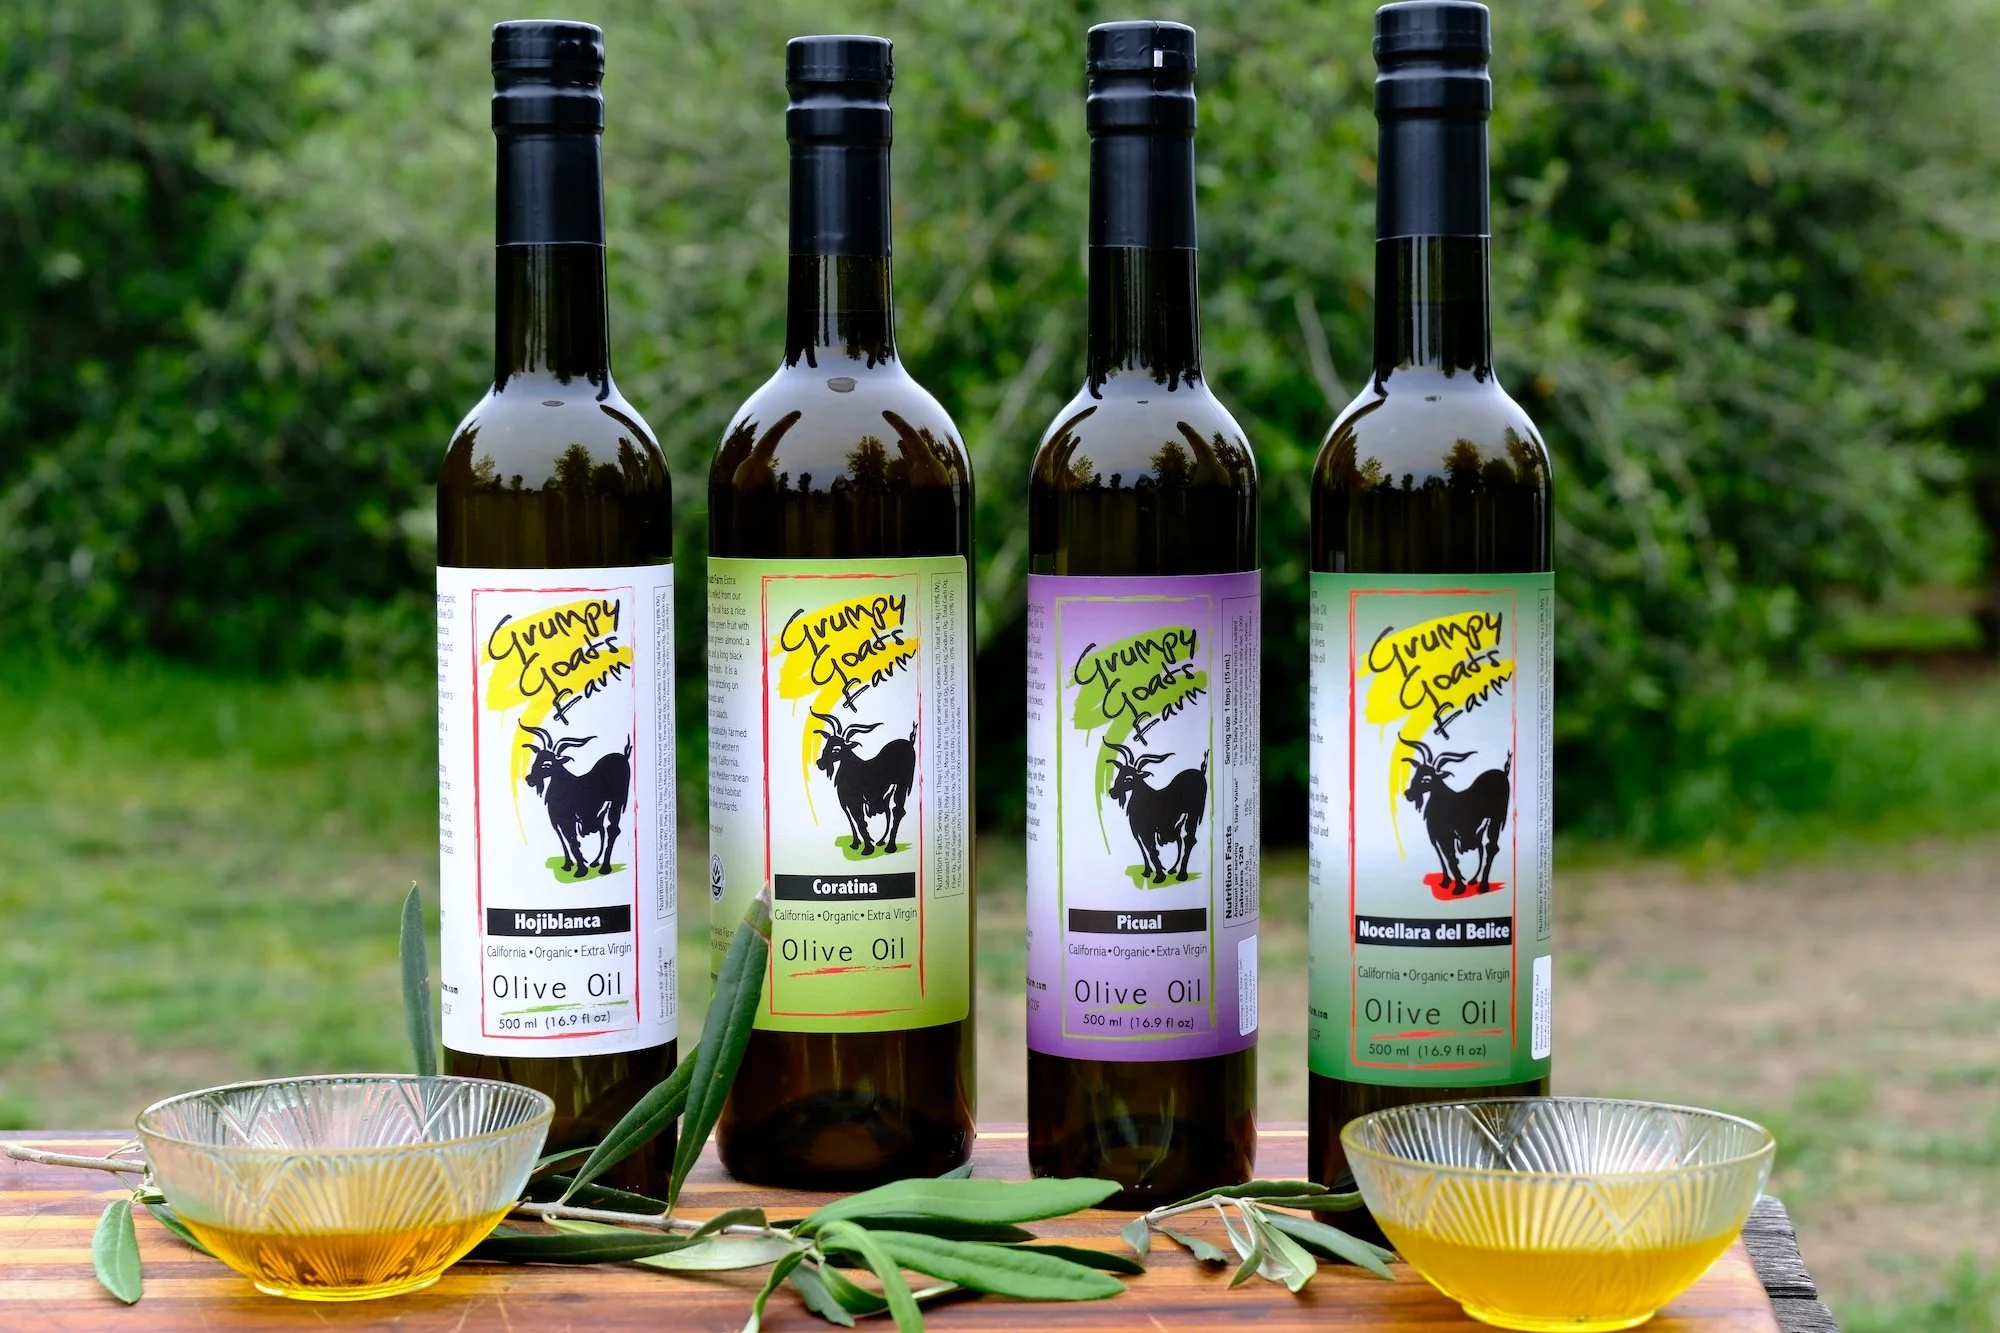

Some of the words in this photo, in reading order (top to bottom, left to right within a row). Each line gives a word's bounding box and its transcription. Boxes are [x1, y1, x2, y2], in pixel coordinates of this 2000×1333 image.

[488, 598, 620, 667] Grumpy
[781, 594, 906, 655] Grumpy
[810, 627, 905, 685] Goats
[1368, 612, 1503, 677] Grumpy
[520, 635, 619, 698] Goats
[1074, 628, 1197, 689] Grumpy
[842, 649, 917, 713] Farm
[1102, 663, 1194, 719] Goats
[1400, 648, 1500, 709] Goats
[553, 661, 630, 725] Farm
[1224, 686, 1232, 706] tbsp.
[1433, 672, 1512, 740] Farm
[1133, 686, 1206, 746] Farm
[1224, 734, 1232, 765] Serving
[813, 879, 877, 895] Coratina
[515, 913, 601, 934] Hojiblanca
[775, 908, 814, 921] California
[822, 909, 859, 924] Organic
[867, 909, 891, 920] Extra
[894, 908, 917, 921] Virgin
[1117, 915, 1162, 930] Picual
[1359, 921, 1430, 940] Nocellara
[1436, 923, 1461, 940] del
[1466, 923, 1510, 939] Belice
[487, 945, 526, 958] California
[535, 945, 573, 960] Organic
[581, 945, 605, 956] Extra
[608, 942, 632, 957] Virgin
[782, 939, 852, 962] Olive
[872, 938, 905, 960] Oil
[1068, 944, 1106, 957] California
[1113, 946, 1150, 959] Organic
[1156, 946, 1180, 956] Extra
[1183, 944, 1207, 957] Virgin
[493, 974, 566, 998] Olive
[588, 972, 621, 997] Oil
[1358, 966, 1400, 980] California
[1408, 968, 1448, 984] Organic
[1457, 969, 1482, 980] Extra
[1485, 968, 1510, 982] Virgin
[1075, 980, 1147, 1005] Olive
[1168, 979, 1201, 1003] Oil
[499, 1018, 520, 1029] 500
[524, 1018, 537, 1028] ml
[546, 1015, 577, 1030] (16.9
[582, 1013, 590, 1025] fl
[594, 1011, 611, 1024] oz)
[1083, 1014, 1105, 1026] 500
[1109, 1016, 1121, 1027] ml
[1130, 1016, 1161, 1029] (16.9
[1166, 1017, 1174, 1027] fl
[1178, 1017, 1194, 1029] oz)
[1365, 998, 1441, 1025] Olive
[1462, 1000, 1496, 1024] Oil
[1369, 1044, 1391, 1055] 500
[1396, 1045, 1409, 1056] ml
[1418, 1046, 1451, 1059] (16.9
[1456, 1045, 1464, 1056] fl
[1469, 1044, 1486, 1056] oz)
